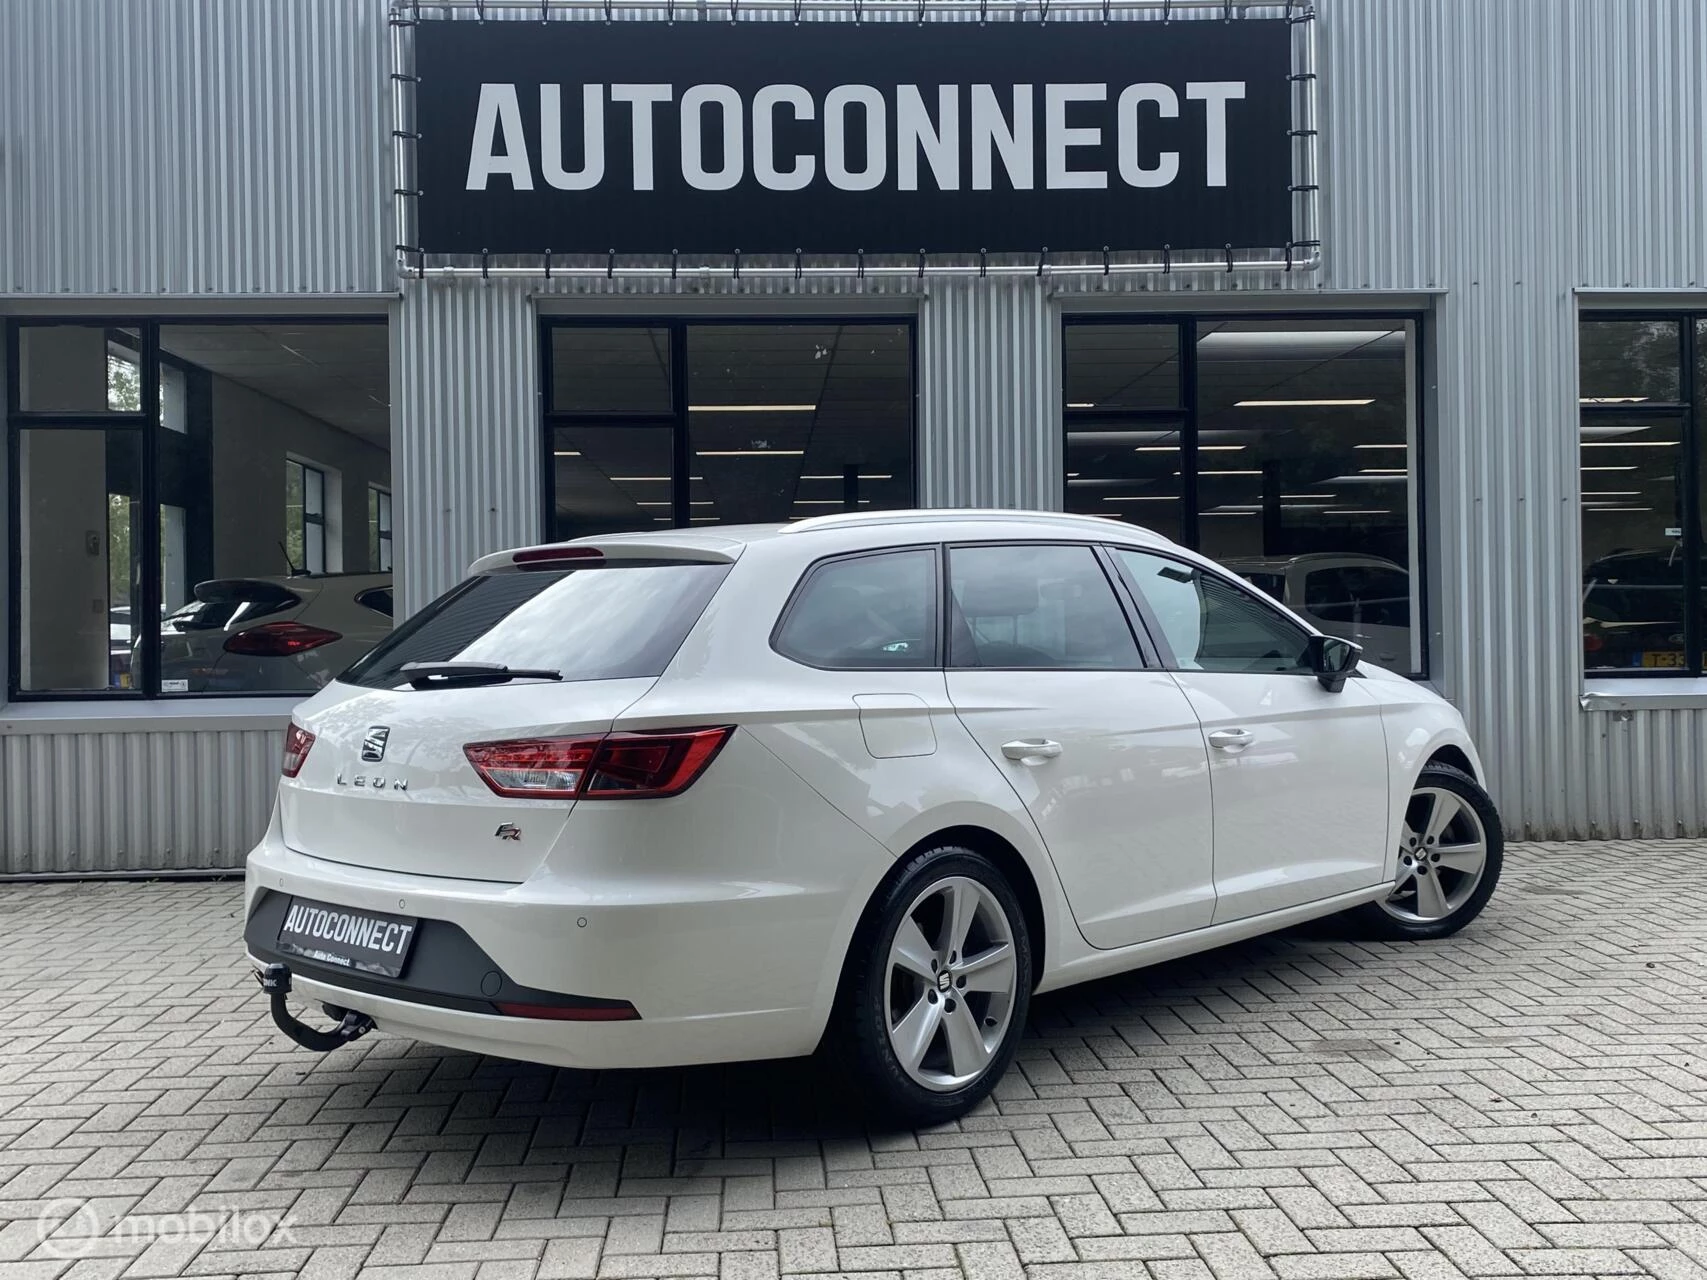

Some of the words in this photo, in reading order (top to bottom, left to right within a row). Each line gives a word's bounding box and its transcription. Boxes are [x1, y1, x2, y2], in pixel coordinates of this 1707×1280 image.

[465, 81, 1246, 191] AUTOCONNECT
[336, 773, 409, 791] LEON
[494, 822, 521, 841] FR
[283, 905, 413, 954] AUTOCONNECT
